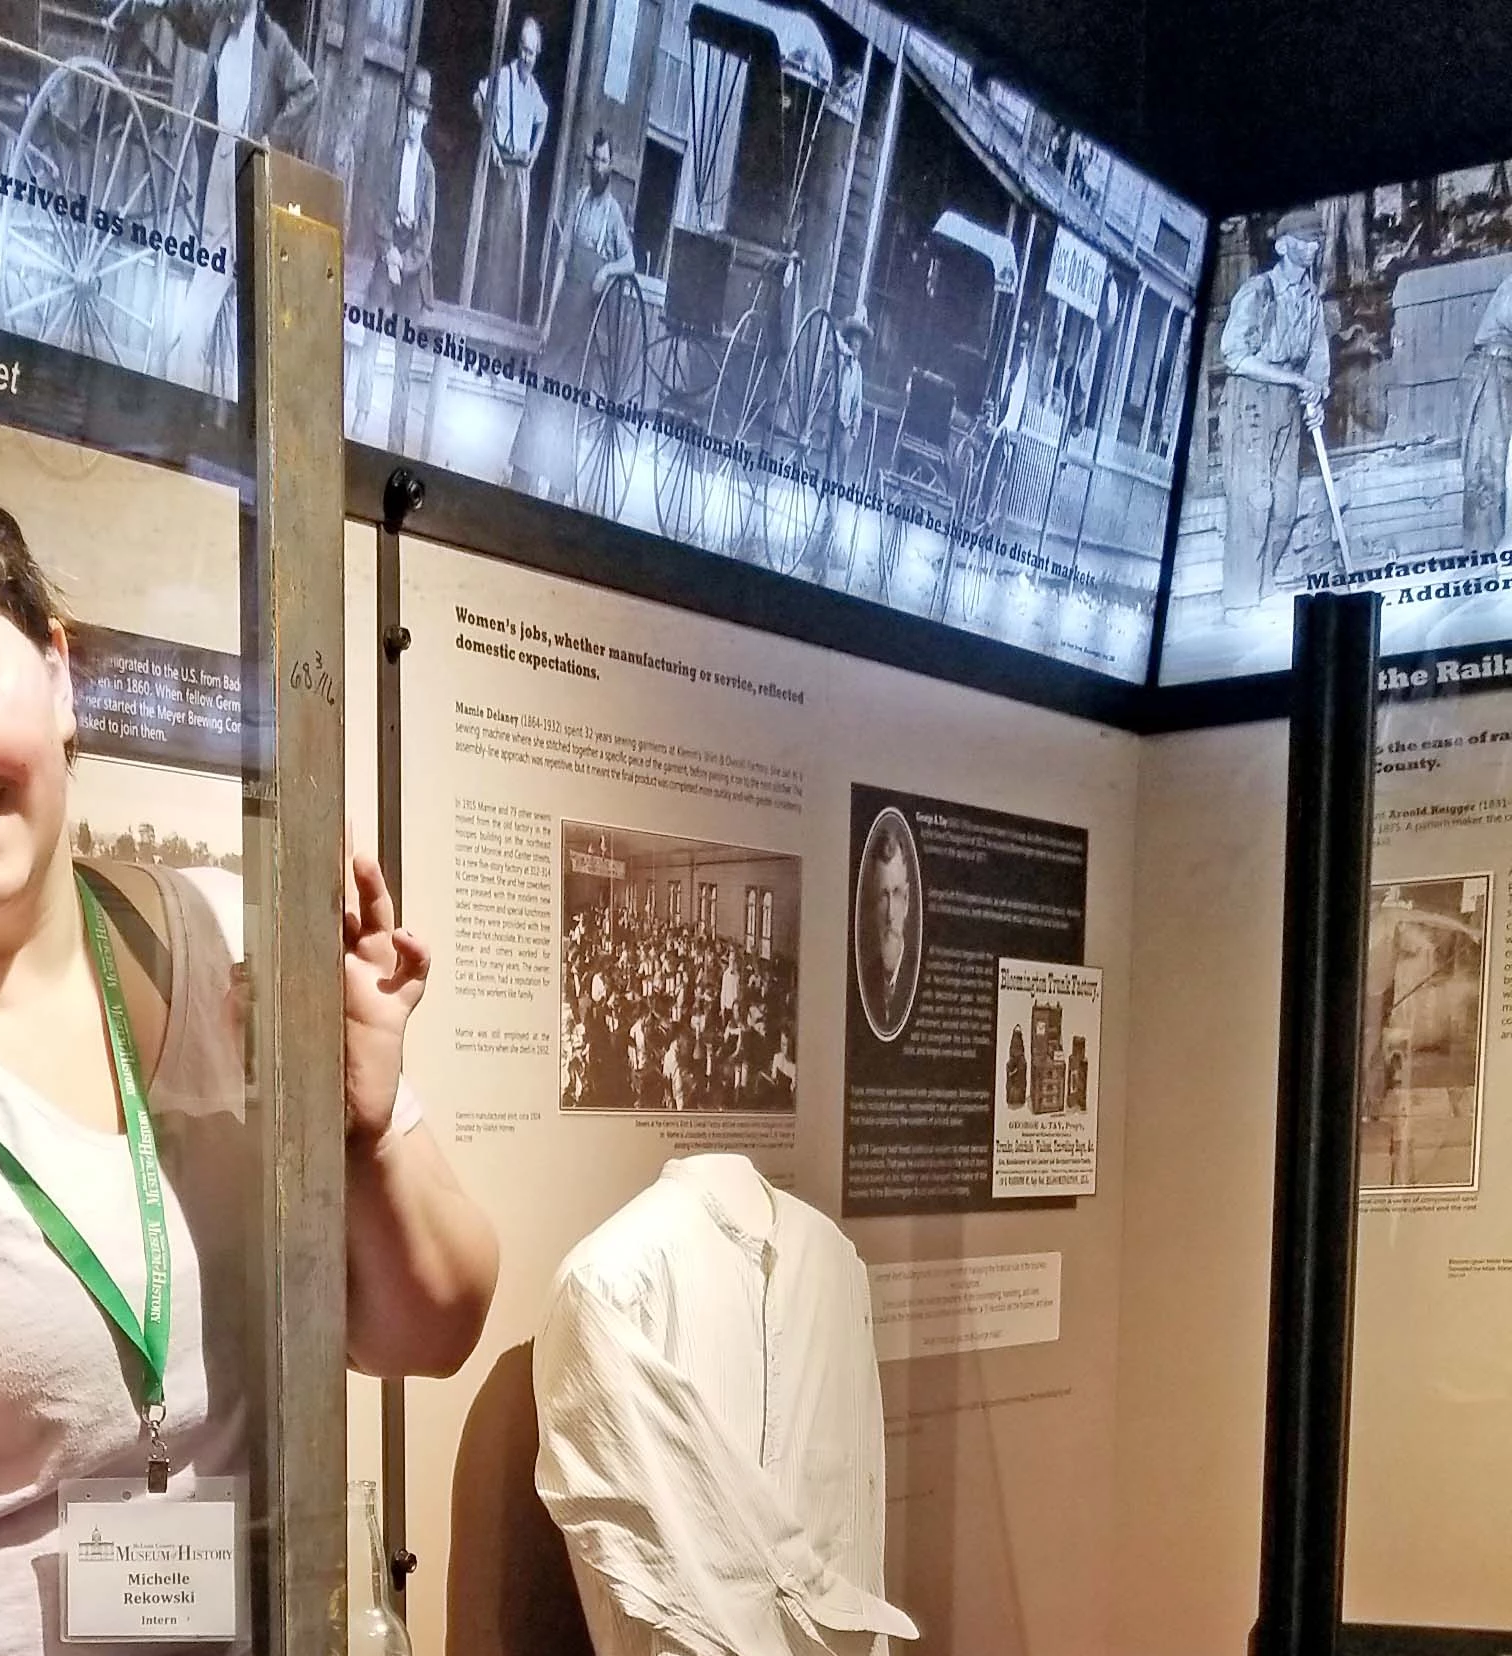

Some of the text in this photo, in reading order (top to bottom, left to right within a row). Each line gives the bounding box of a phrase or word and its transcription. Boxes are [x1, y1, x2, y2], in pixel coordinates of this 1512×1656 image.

[93, 204, 124, 236] as
[131, 221, 227, 275] needed
[402, 316, 428, 349] be
[433, 332, 515, 382] shipped
[518, 360, 538, 389] in
[542, 376, 591, 407] more
[756, 449, 818, 488] finished
[820, 474, 884, 513] products
[886, 498, 924, 528] could
[926, 512, 942, 535] be
[943, 517, 995, 557] shipped
[995, 537, 1008, 557] to
[1009, 541, 1051, 572] distant
[1051, 561, 1099, 589] markets.
[1306, 550, 1512, 591] Manufacturing
[456, 606, 805, 705] Women's jobs, whether manufacturing or service, reflected
[456, 634, 600, 681] domestic expectations.
[151, 662, 162, 677] to
[163, 663, 179, 679] the
[181, 667, 198, 683] U.S.
[200, 669, 221, 688] from
[1377, 667, 1428, 691] the
[114, 675, 124, 690] in
[126, 677, 153, 697] 1860.
[155, 682, 183, 702] When
[186, 688, 213, 708] fellow
[103, 699, 223, 734] started the Meyer Brewing
[486, 707, 519, 728] Delaney
[108, 718, 167, 742] to join them.
[116, 1544, 232, 1562] MUSEUM HISTORY
[128, 1572, 190, 1586] Michelle
[123, 1591, 195, 1605] Rekowski
[141, 1615, 177, 1625] Intern
